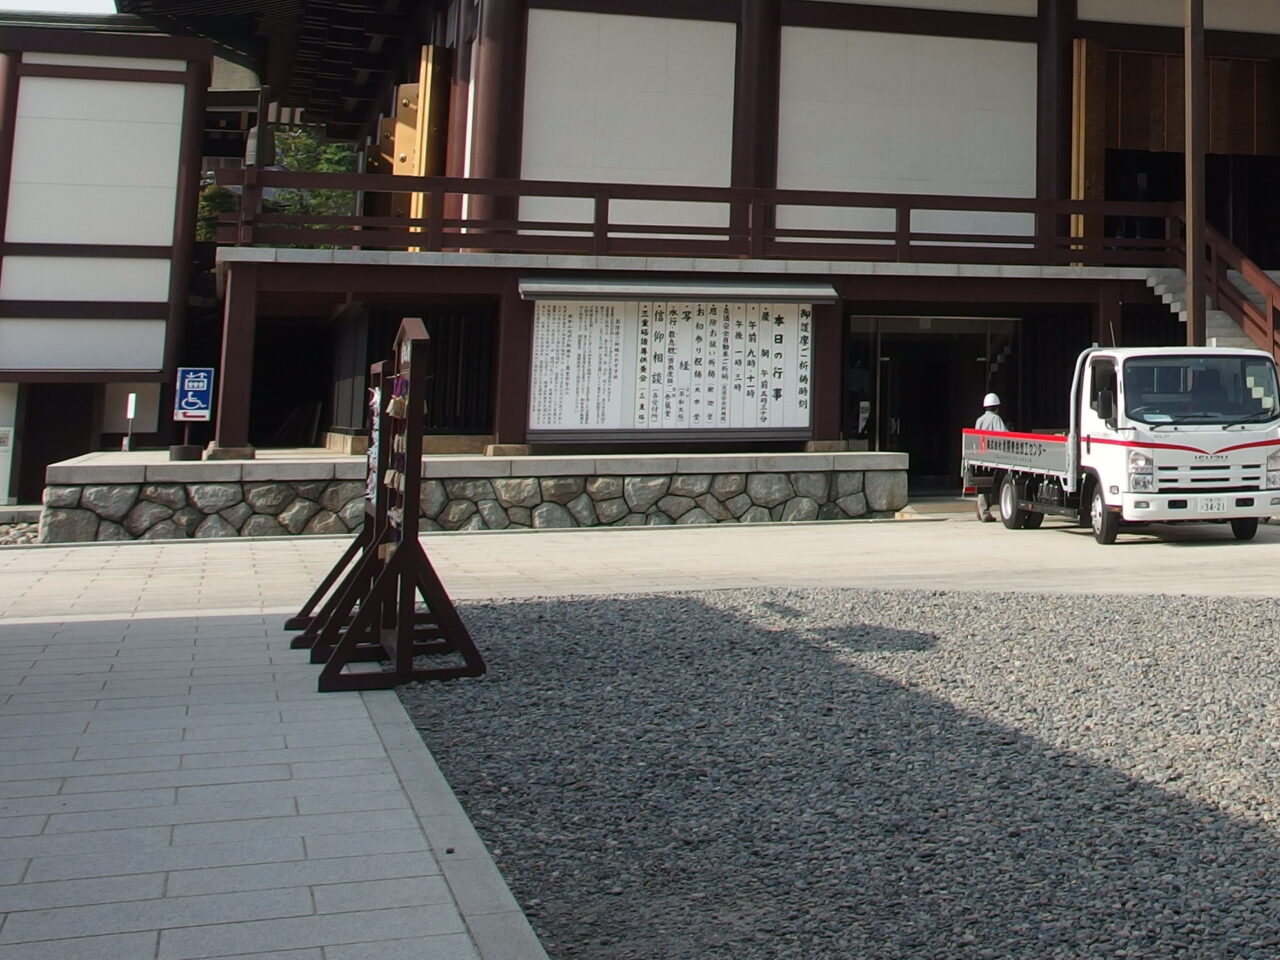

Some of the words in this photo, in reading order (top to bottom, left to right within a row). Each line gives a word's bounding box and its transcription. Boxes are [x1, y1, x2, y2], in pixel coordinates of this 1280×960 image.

[772, 313, 785, 402] 本日の行事
[1204, 502, 1225, 512] 34-21
